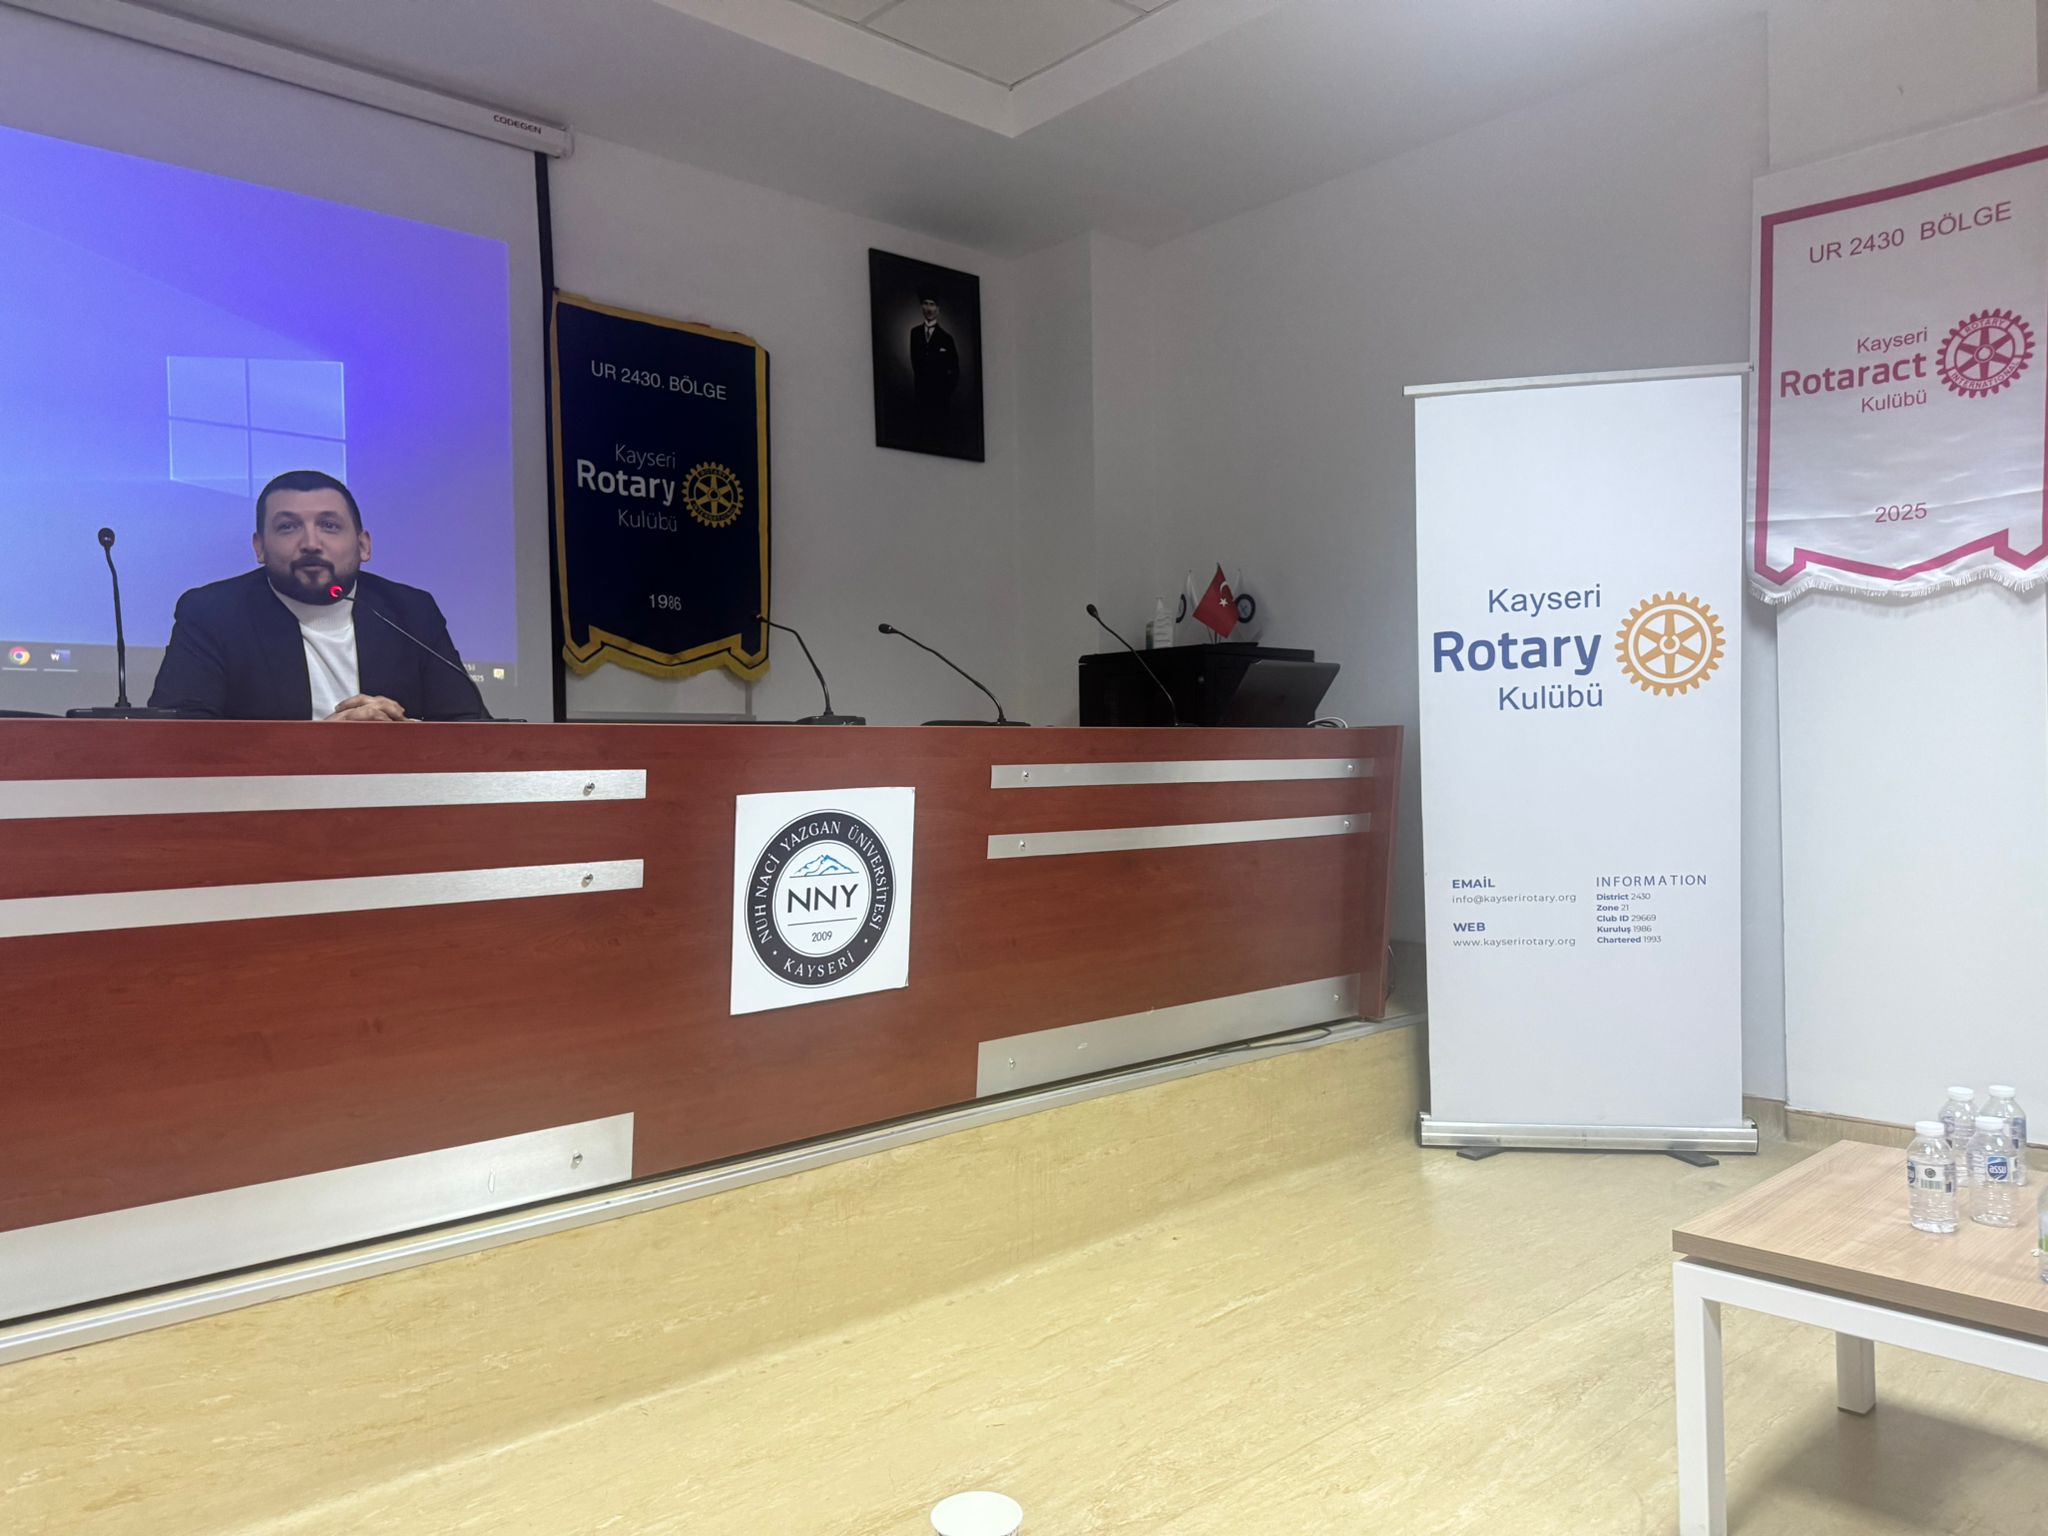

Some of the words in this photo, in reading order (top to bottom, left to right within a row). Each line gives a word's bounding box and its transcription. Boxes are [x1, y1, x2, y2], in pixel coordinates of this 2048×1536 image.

[493, 114, 542, 135] CODEGEN
[1808, 241, 1843, 264] UR
[1850, 228, 1904, 256] 2430
[1920, 201, 2012, 241] BÖLGE
[1965, 318, 2007, 334] ROTARY
[1856, 326, 1928, 354] Kayseri
[591, 359, 617, 381] UR
[620, 367, 665, 389] 2430.
[669, 375, 727, 401] BÖLGE
[1779, 351, 1927, 398] Rotaract
[1951, 361, 2019, 389] INTERNATIONAL
[1861, 389, 1928, 413] Kulübü
[615, 443, 676, 471] Kayseri
[576, 458, 676, 507] Rotary
[617, 508, 678, 532] Kulübü
[1874, 502, 1928, 523] 2025
[649, 594, 682, 611] 1986
[1488, 583, 1601, 617] Kayseri
[1433, 630, 1602, 676] Rotary
[1498, 683, 1603, 711] Kulübü
[779, 821, 841, 852] YAZGAN
[755, 853, 780, 898] NACİ
[847, 824, 890, 931] ÜNİVERSİTESİ
[1452, 876, 1496, 889] EMAİL
[1596, 874, 1707, 887] INFORMATION
[787, 883, 859, 913] NNY
[1452, 893, 1577, 905] info@kayserirotary.org
[1596, 893, 1629, 901] District
[1630, 892, 1651, 900] 2430
[754, 904, 773, 944] NUH
[1453, 922, 1486, 932] WEB
[1596, 914, 1618, 922] Club
[1631, 914, 1657, 922] 29669
[1596, 925, 1631, 934] Kuruluş
[811, 931, 833, 942] 2009
[1453, 936, 1576, 948] www.kayserirotary.org
[1597, 936, 1642, 944] Chartered
[1643, 935, 1662, 943] 1993
[783, 949, 855, 978] KAYSERİ
